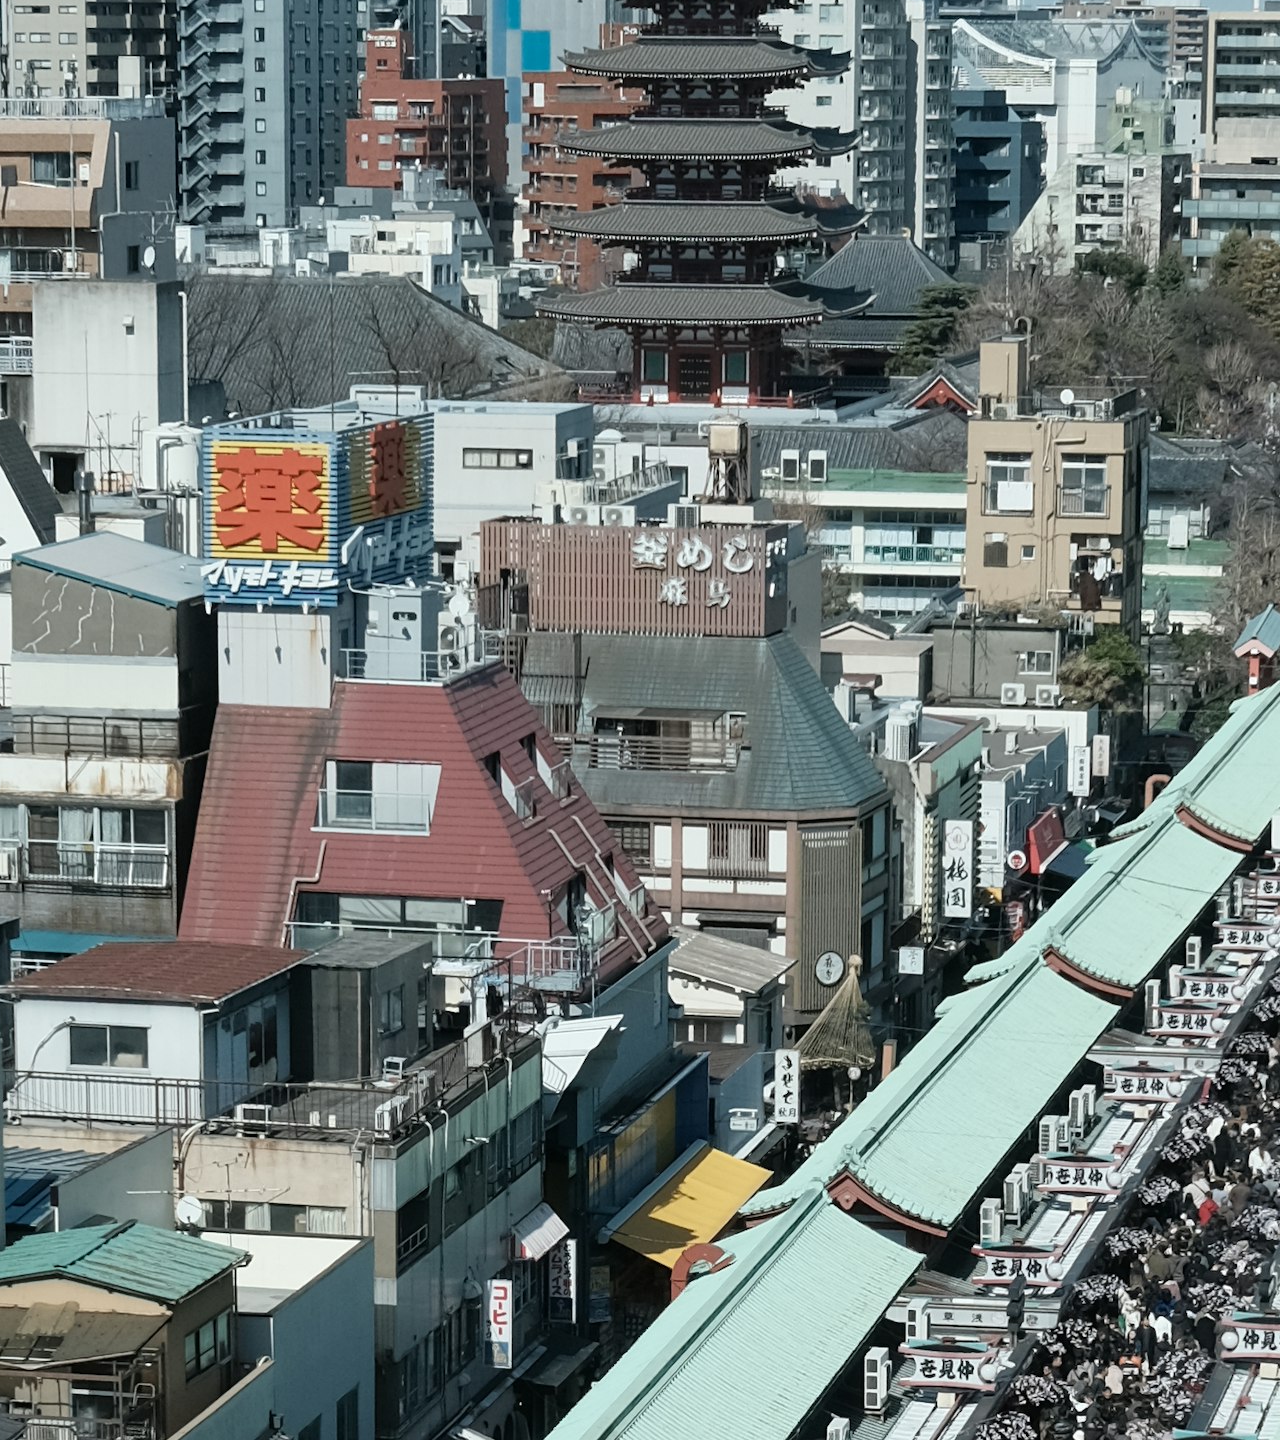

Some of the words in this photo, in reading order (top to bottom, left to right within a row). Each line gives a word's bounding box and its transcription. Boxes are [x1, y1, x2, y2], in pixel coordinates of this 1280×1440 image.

[370, 420, 406, 517] 薬
[215, 447, 324, 552] 薬
[632, 532, 754, 573] 釜めし
[200, 559, 339, 596] マツモトキヨシ
[493, 1286, 507, 1335] コーヒー
